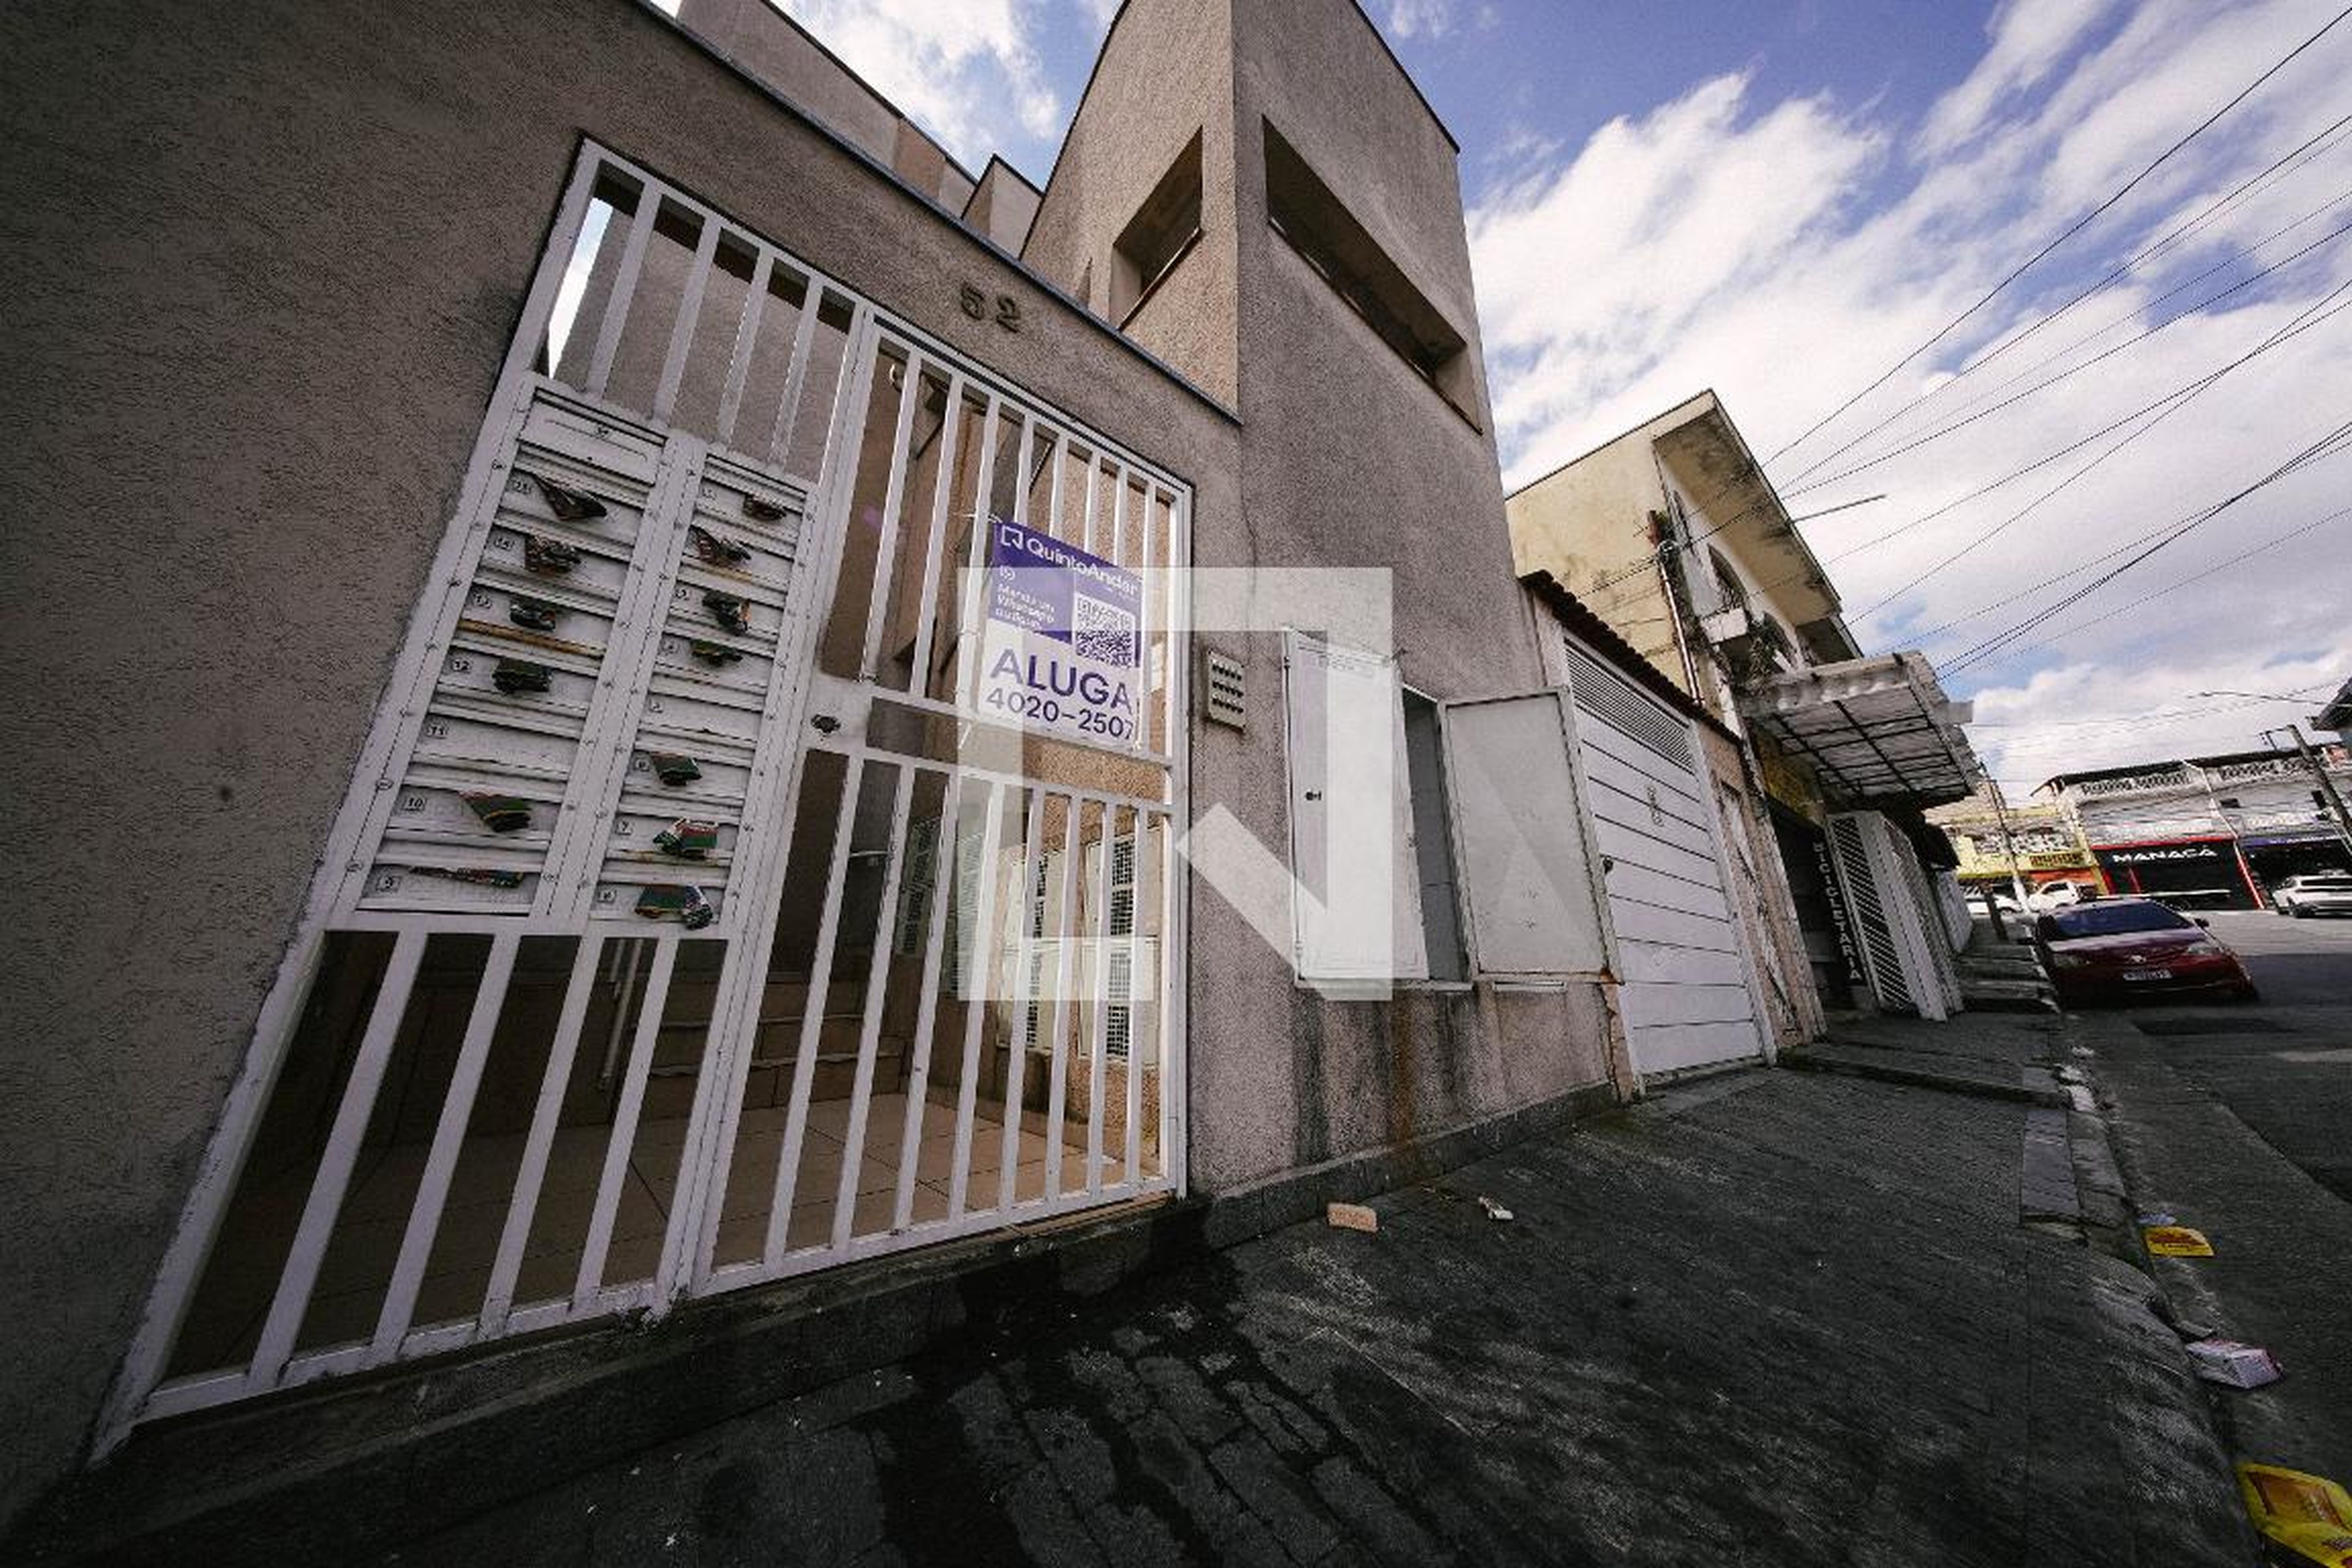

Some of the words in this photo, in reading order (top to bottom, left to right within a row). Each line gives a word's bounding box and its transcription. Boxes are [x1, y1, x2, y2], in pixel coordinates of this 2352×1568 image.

[960, 283, 1020, 333] 52
[1027, 538, 1138, 595] QuintoAndar
[990, 648, 1134, 715] ALUGA
[986, 687, 1134, 740] 4020-2507
[408, 797, 424, 808] 10
[2112, 845, 2218, 863] MANACÁ
[1813, 842, 1864, 980] BICICLETARIA
